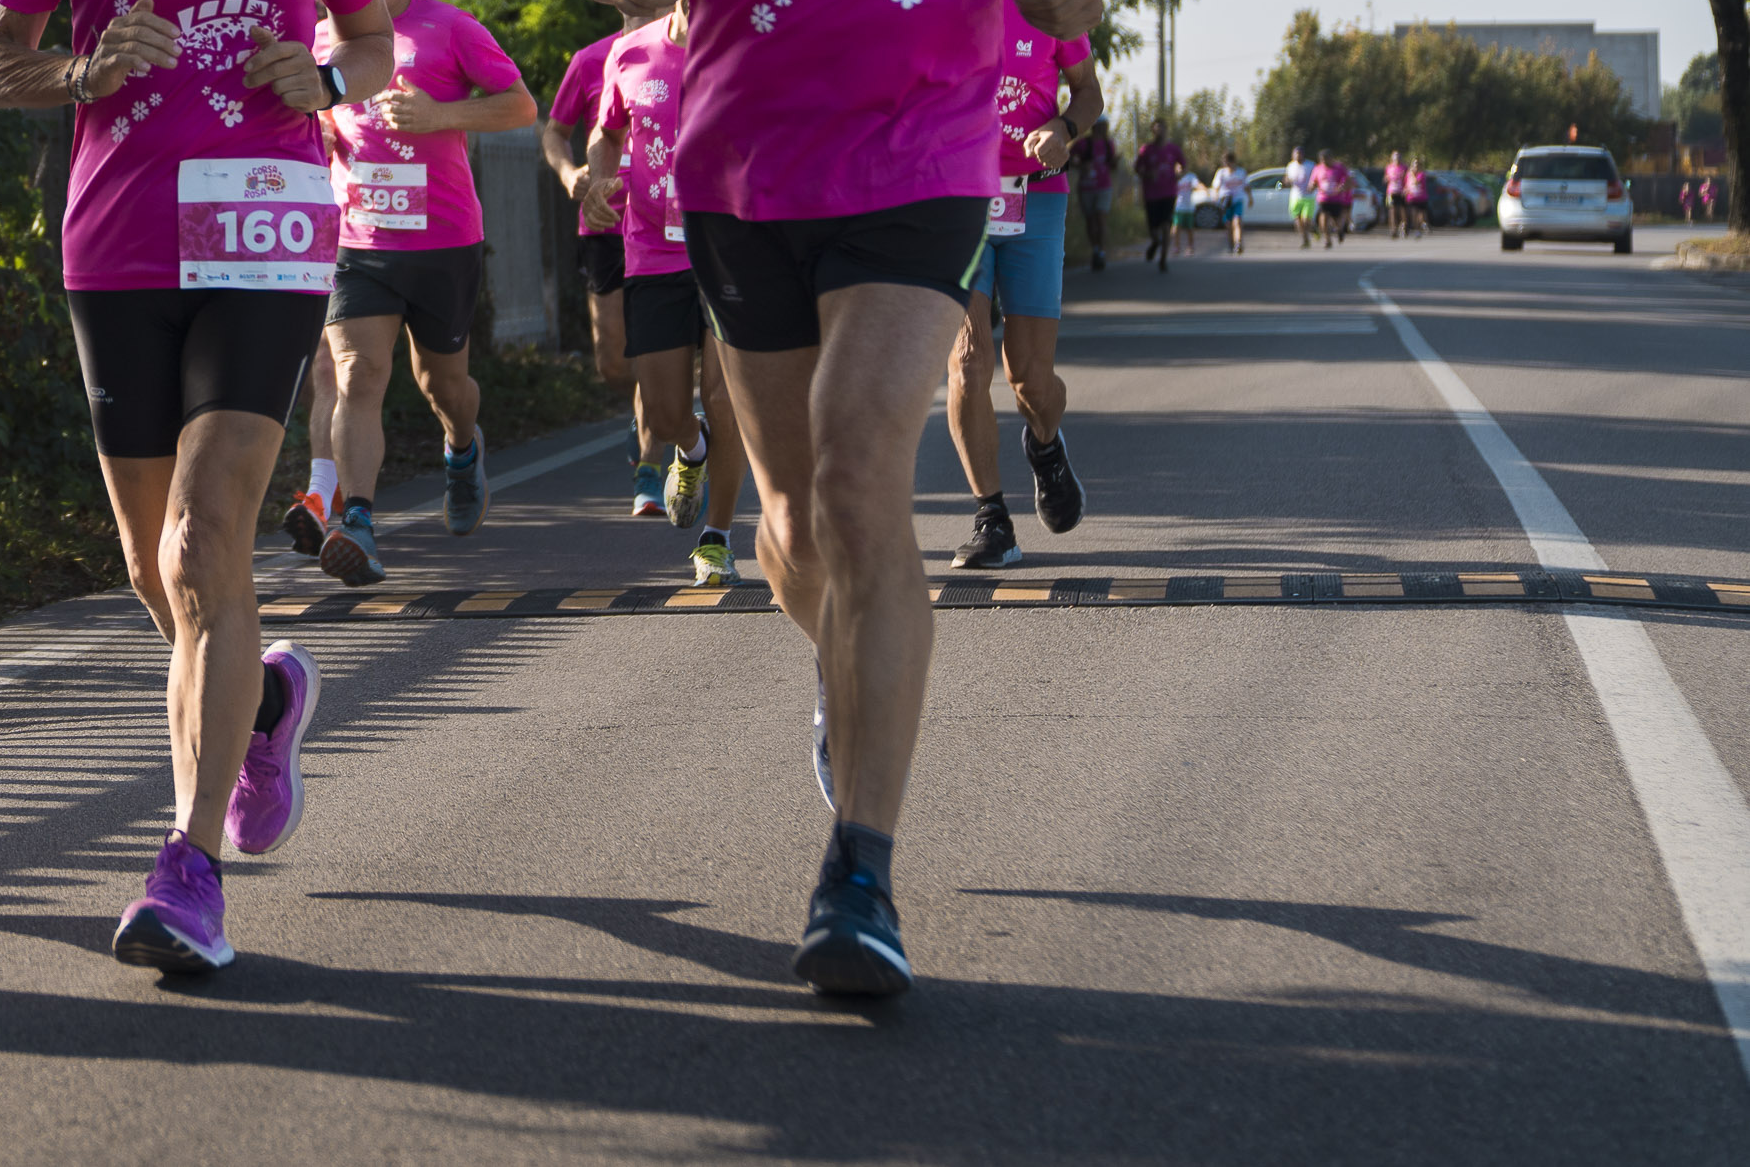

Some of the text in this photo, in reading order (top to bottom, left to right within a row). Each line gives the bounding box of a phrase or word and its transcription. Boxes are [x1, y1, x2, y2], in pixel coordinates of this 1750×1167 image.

[252, 165, 278, 176] CORSA
[244, 188, 267, 198] ROSA
[359, 188, 409, 212] 396
[216, 210, 314, 254] 160
